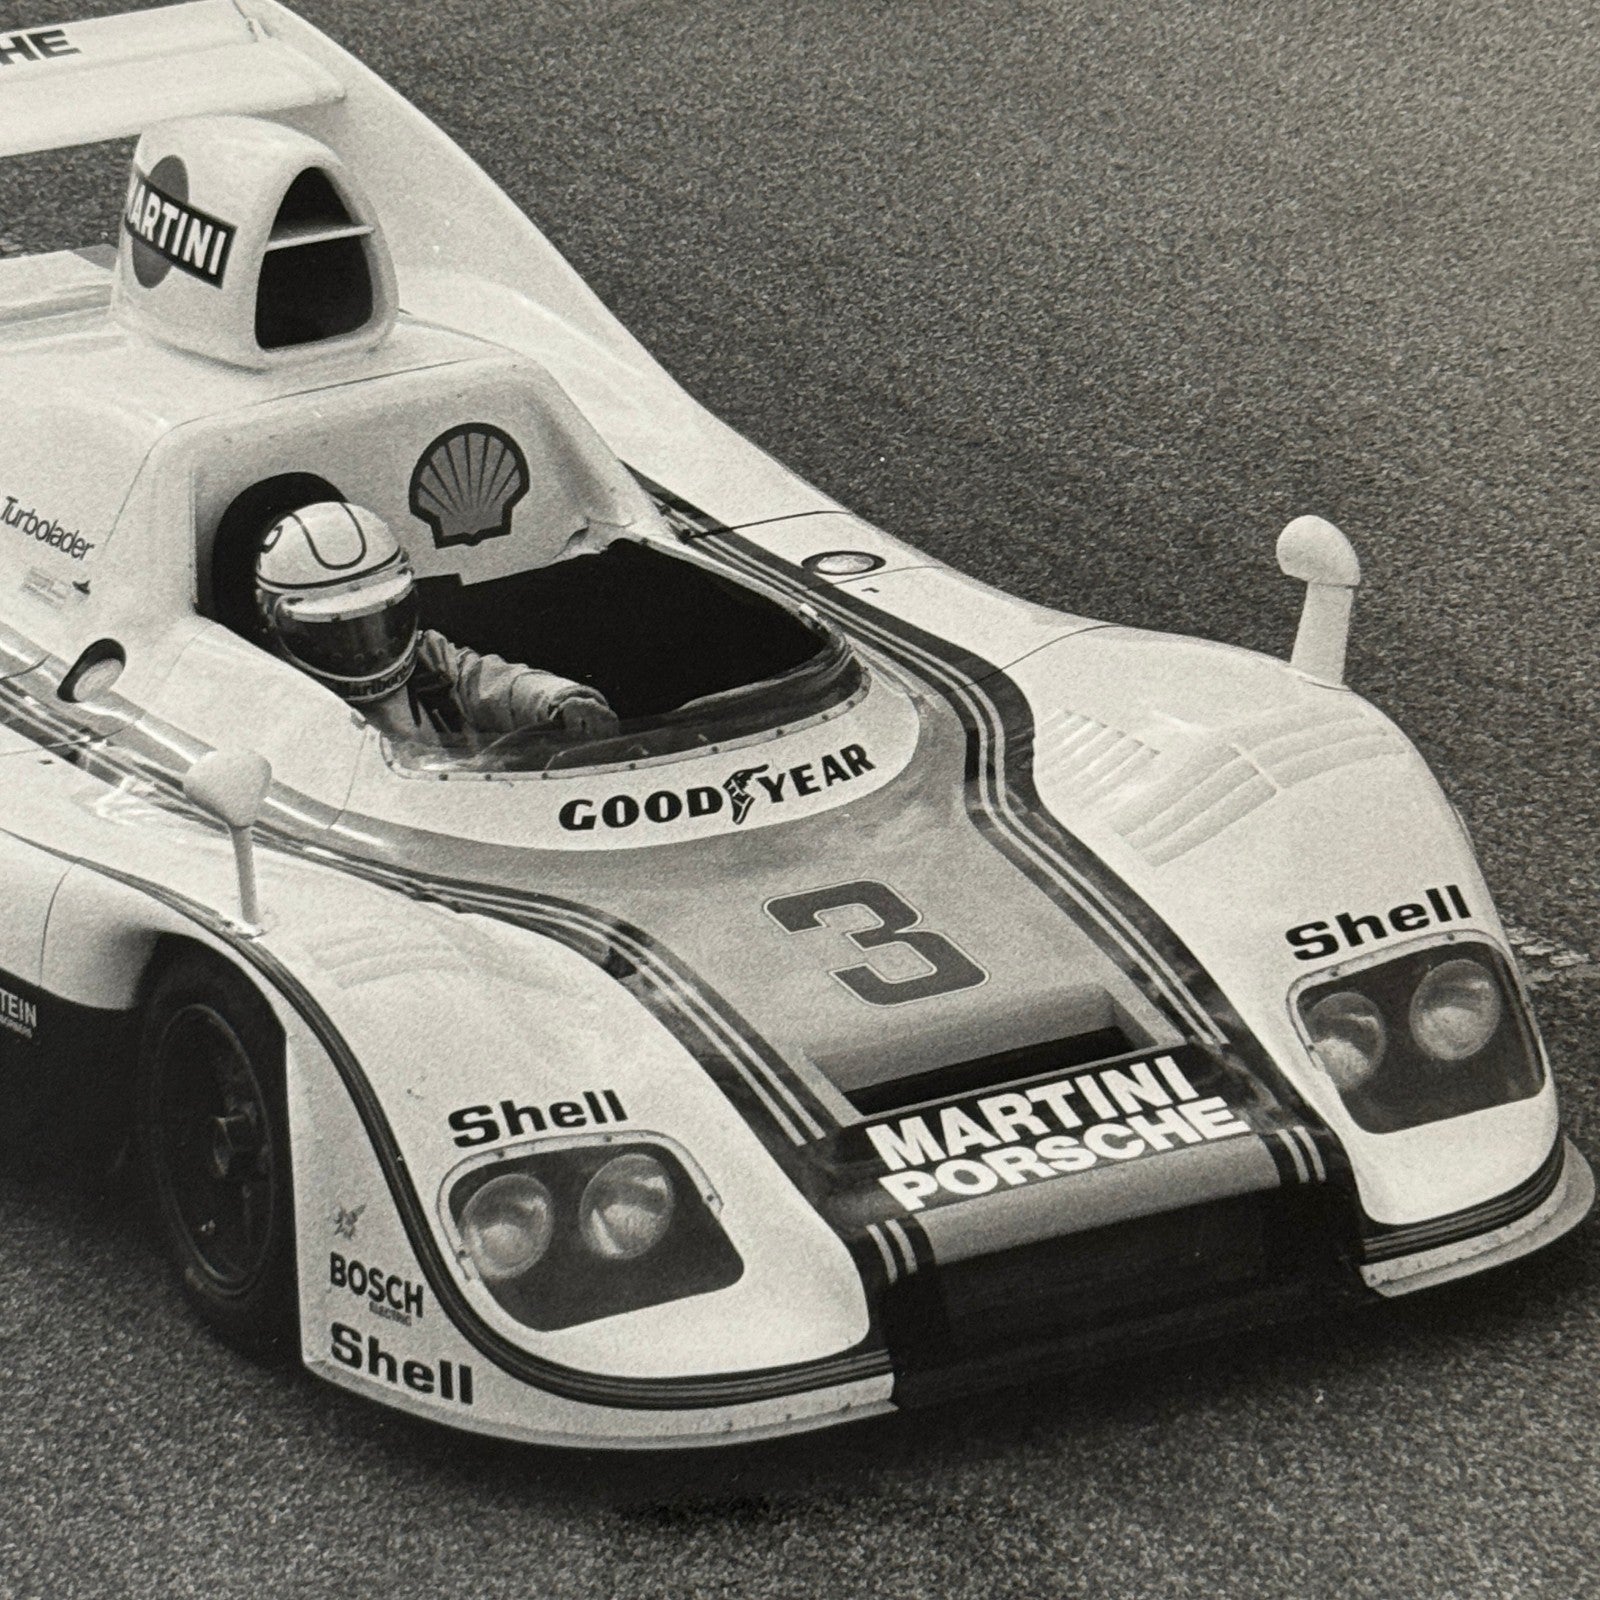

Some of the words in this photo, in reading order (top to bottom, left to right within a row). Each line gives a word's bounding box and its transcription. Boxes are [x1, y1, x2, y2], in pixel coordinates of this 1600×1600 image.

[0, 495, 95, 560] Turbolader
[763, 879, 989, 1006] 3
[1285, 884, 1472, 960] Shell
[448, 1089, 628, 1148] Shell
[865, 1055, 1199, 1170] MARTINI
[878, 1096, 1251, 1211] PORSCHE
[330, 1251, 424, 1318] BOSCH
[331, 1321, 474, 1405] Shell
